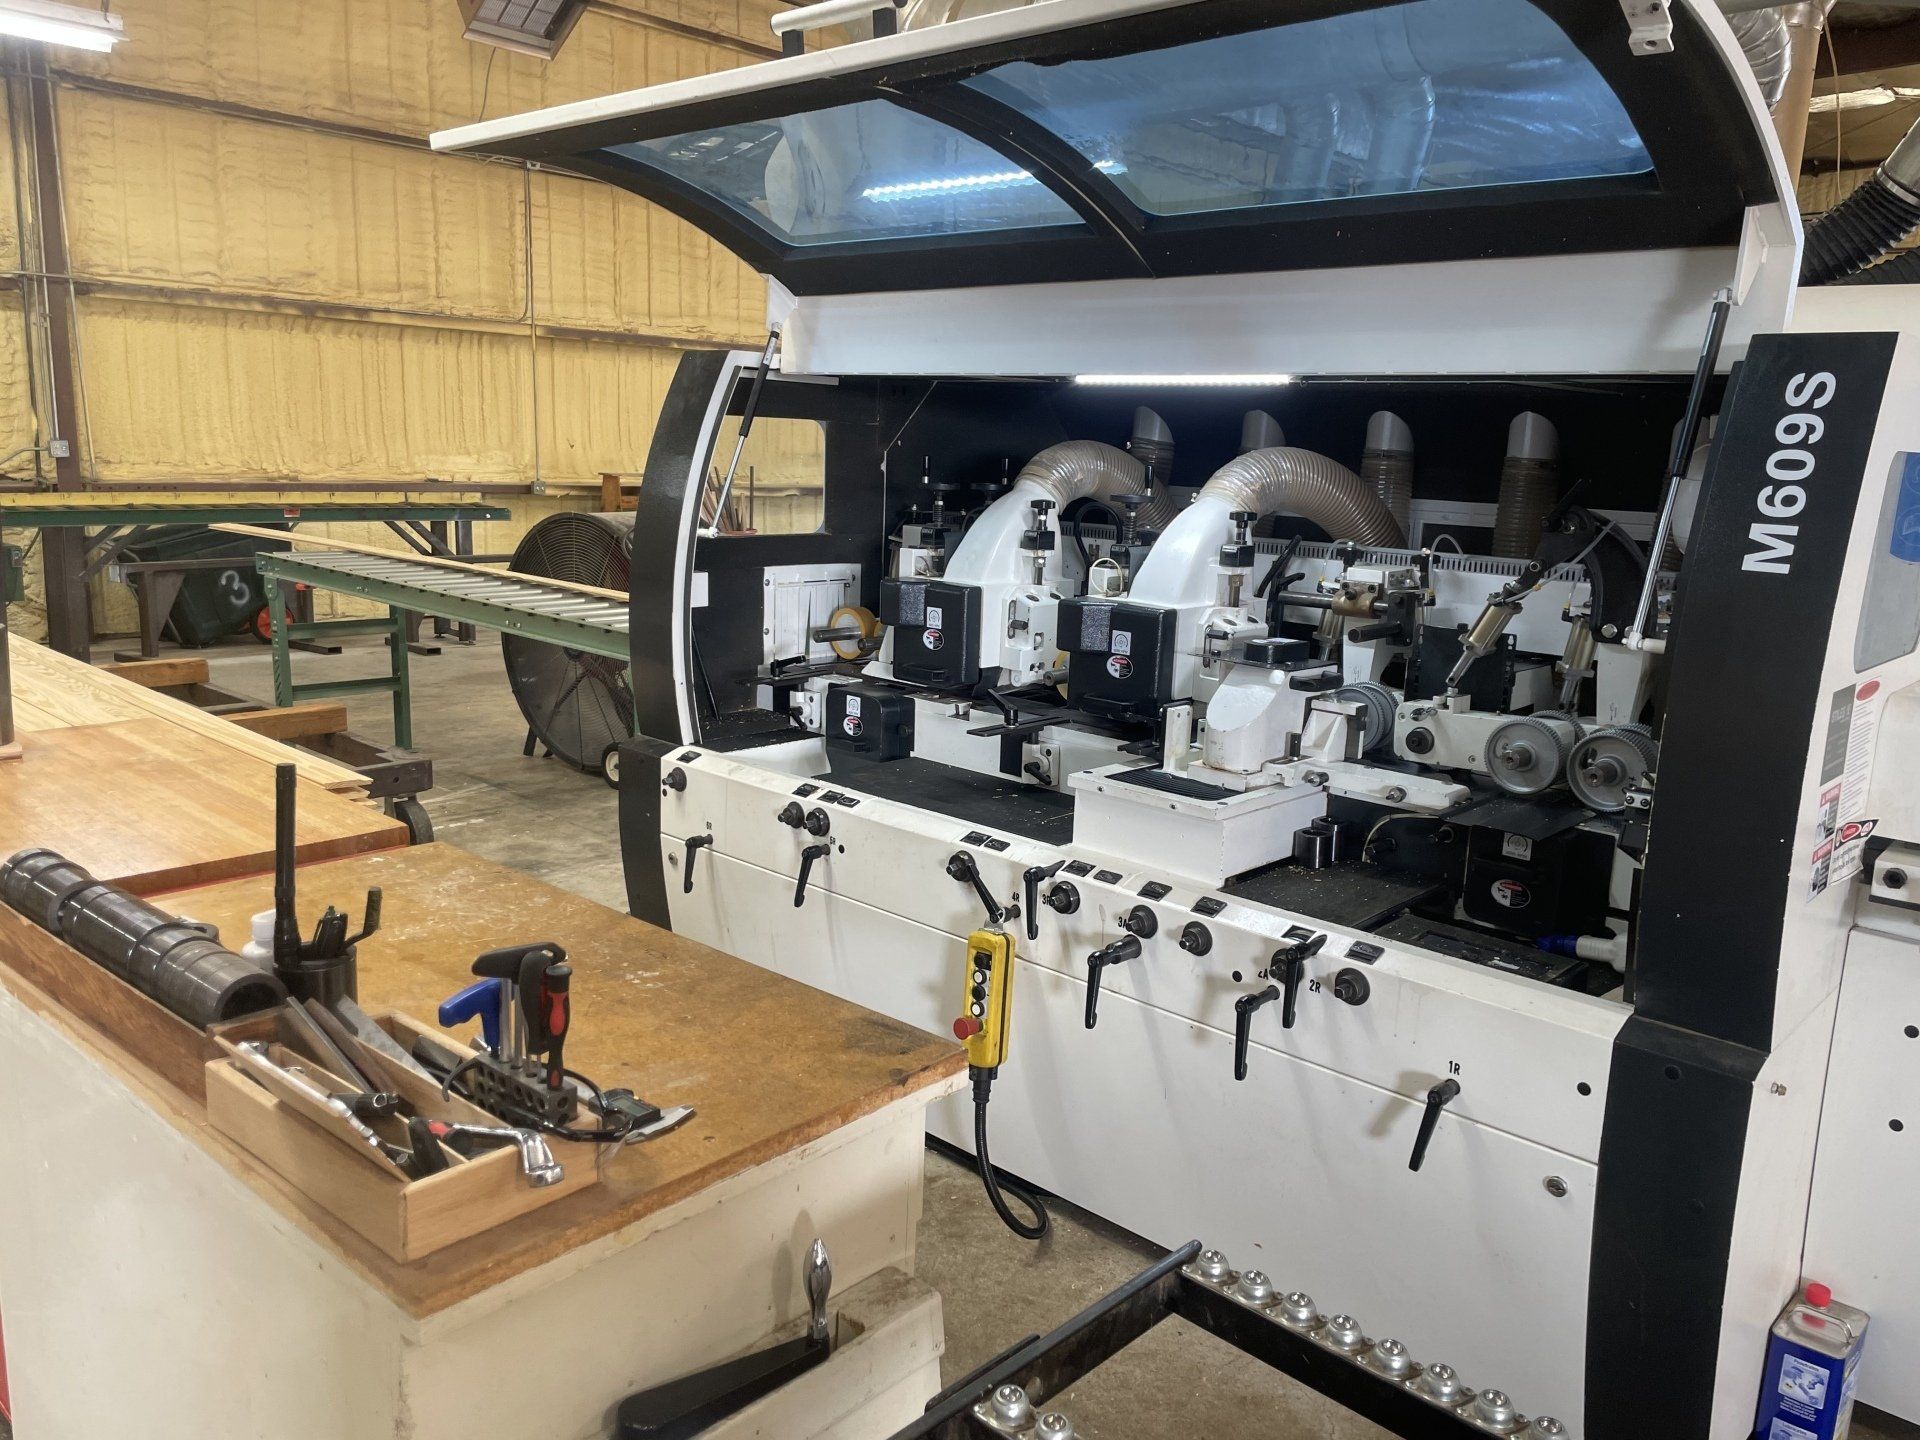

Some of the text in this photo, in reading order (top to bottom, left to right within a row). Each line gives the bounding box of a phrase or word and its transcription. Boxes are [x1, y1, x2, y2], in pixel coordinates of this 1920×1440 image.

[1741, 372, 1837, 575] M609S
[221, 570, 250, 605] 3
[1012, 892, 1020, 903] 4R
[1309, 979, 1321, 993] 2R
[1449, 1060, 1461, 1076] 1R
